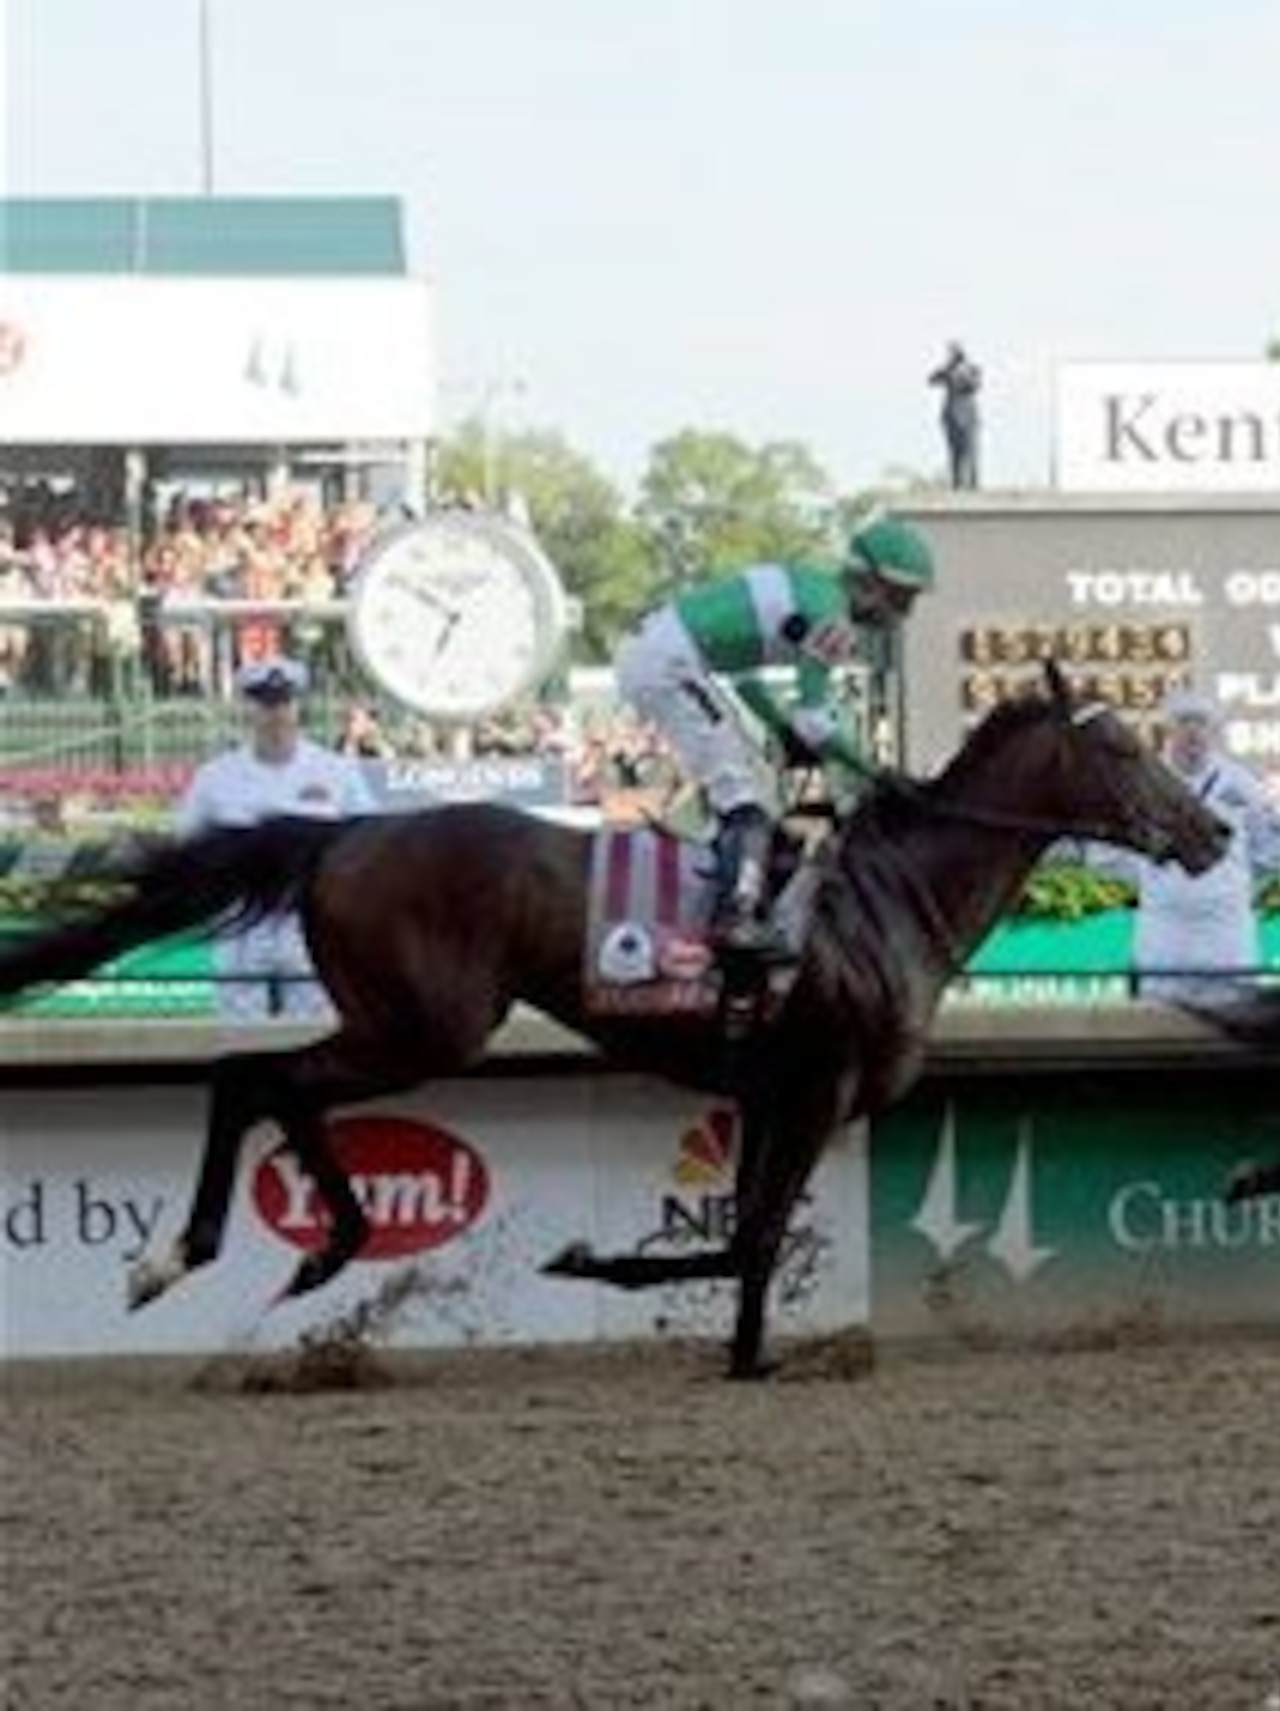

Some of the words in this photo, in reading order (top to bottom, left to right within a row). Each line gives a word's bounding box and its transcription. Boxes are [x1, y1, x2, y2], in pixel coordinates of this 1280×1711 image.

[1066, 571, 1203, 603] TOTAL
[74, 1179, 164, 1263] by
[269, 1151, 471, 1230] Ym!
